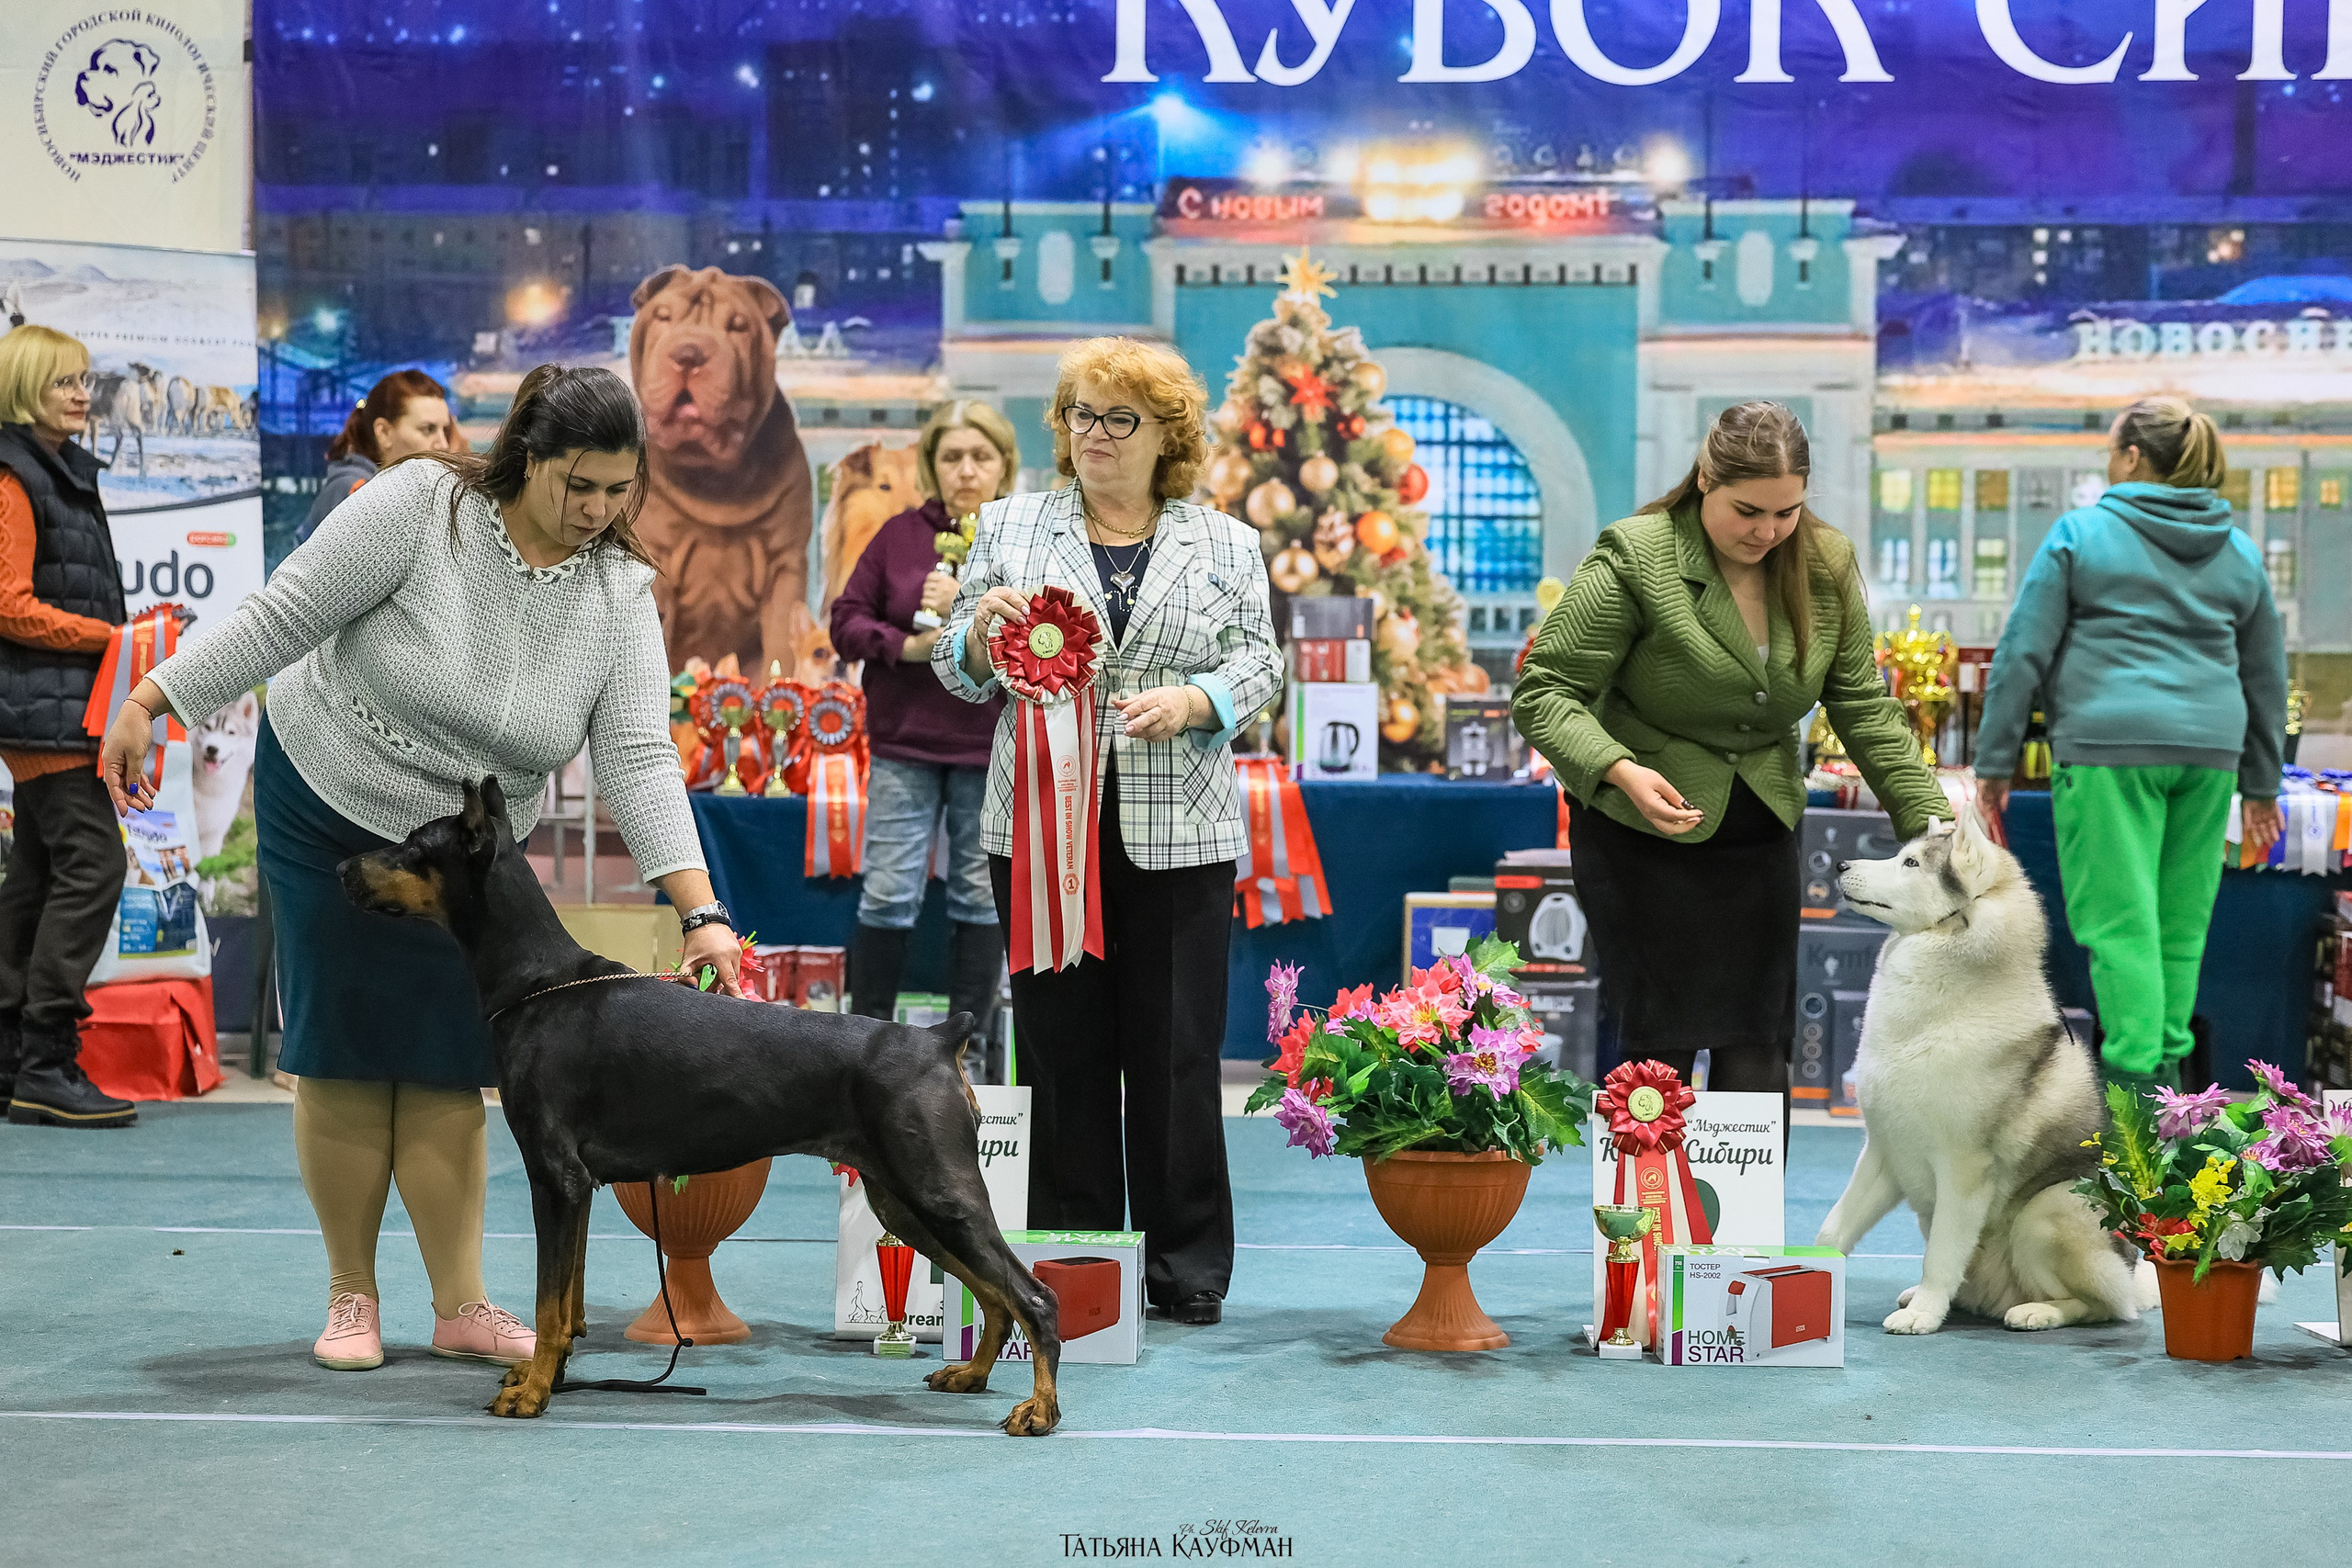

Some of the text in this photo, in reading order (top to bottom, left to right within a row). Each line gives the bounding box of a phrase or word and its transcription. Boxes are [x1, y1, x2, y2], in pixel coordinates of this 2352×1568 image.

[116, 550, 214, 599] udo
[1066, 840, 1074, 870] VETERAN
[1686, 1139, 1774, 1176] Сибири
[1688, 1330, 1745, 1345] HOME
[1688, 1346, 1745, 1362] STAR
